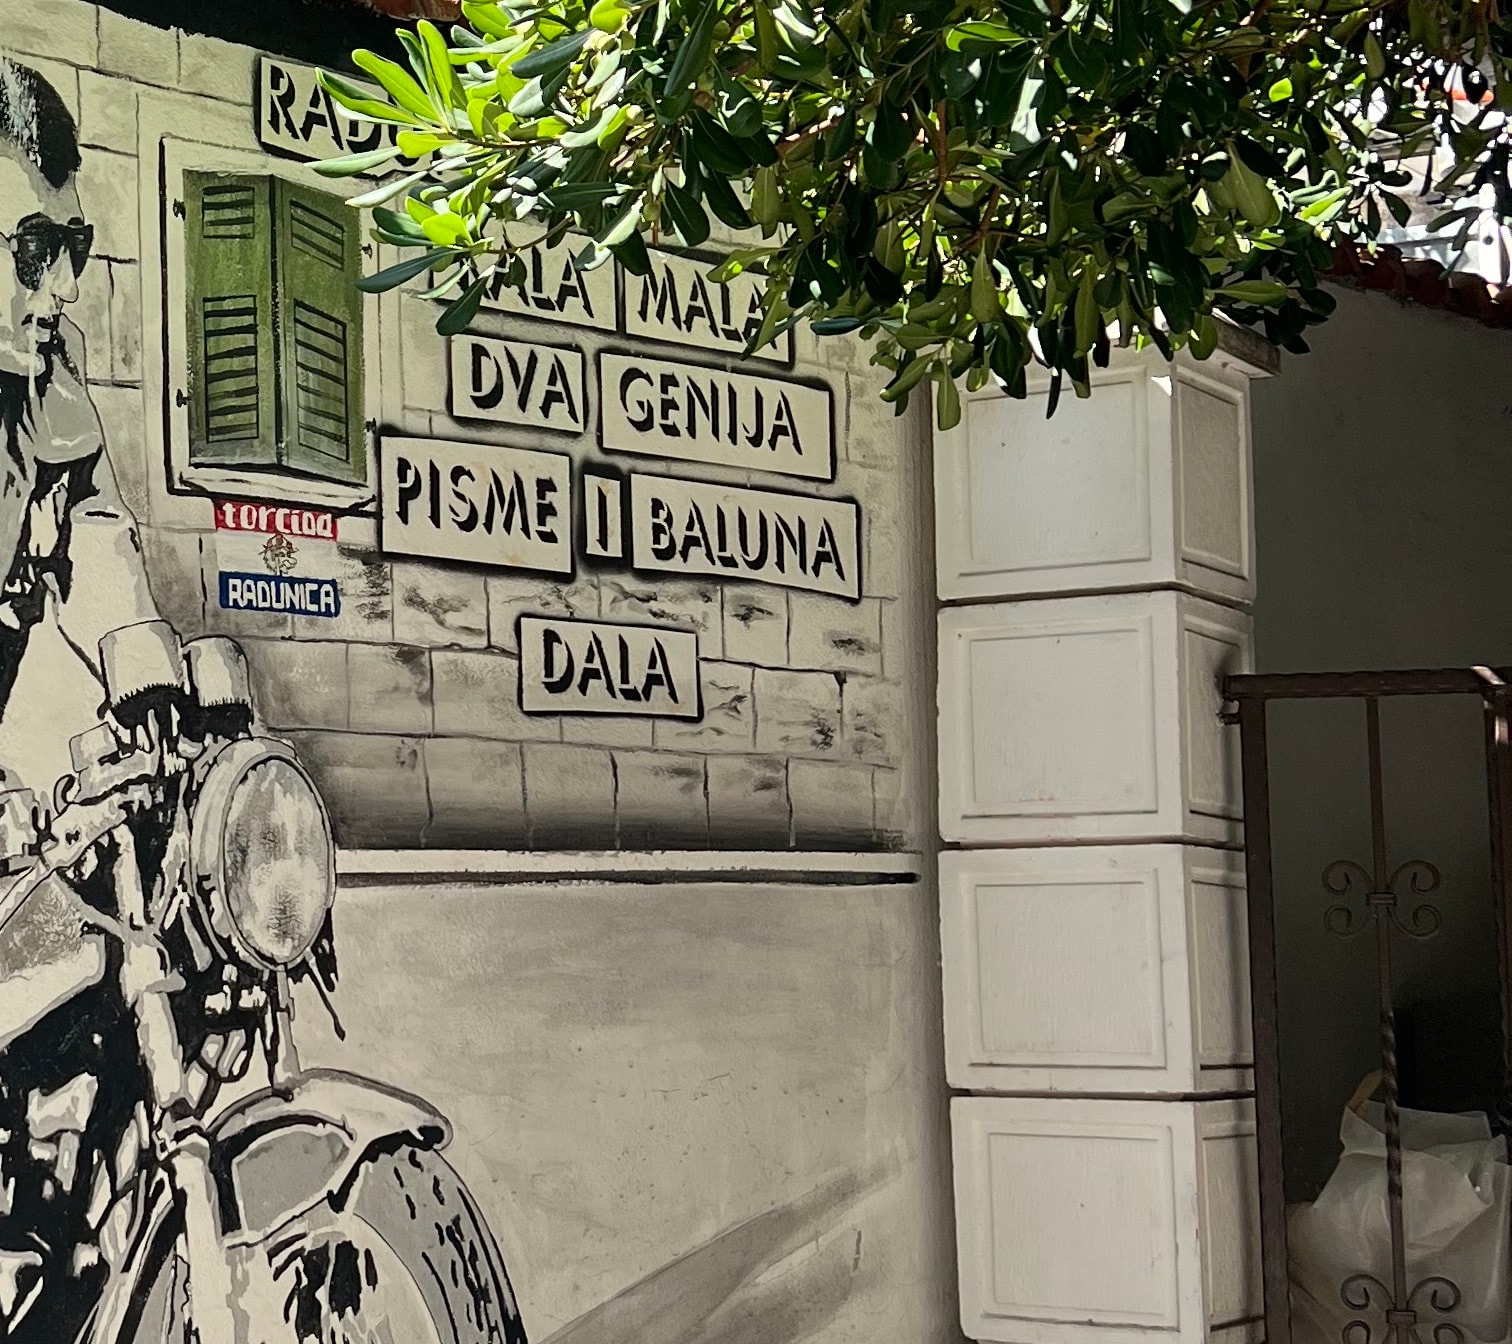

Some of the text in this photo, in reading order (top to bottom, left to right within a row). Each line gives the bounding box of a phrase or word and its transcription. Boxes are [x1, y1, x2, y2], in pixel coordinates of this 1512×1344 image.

[638, 253, 778, 351] MALA
[471, 342, 803, 456] DVA GENIJA
[396, 456, 558, 546] PISME
[650, 498, 846, 582] BALUNA
[228, 578, 336, 613] RADUNICA
[543, 629, 678, 704] DALA
